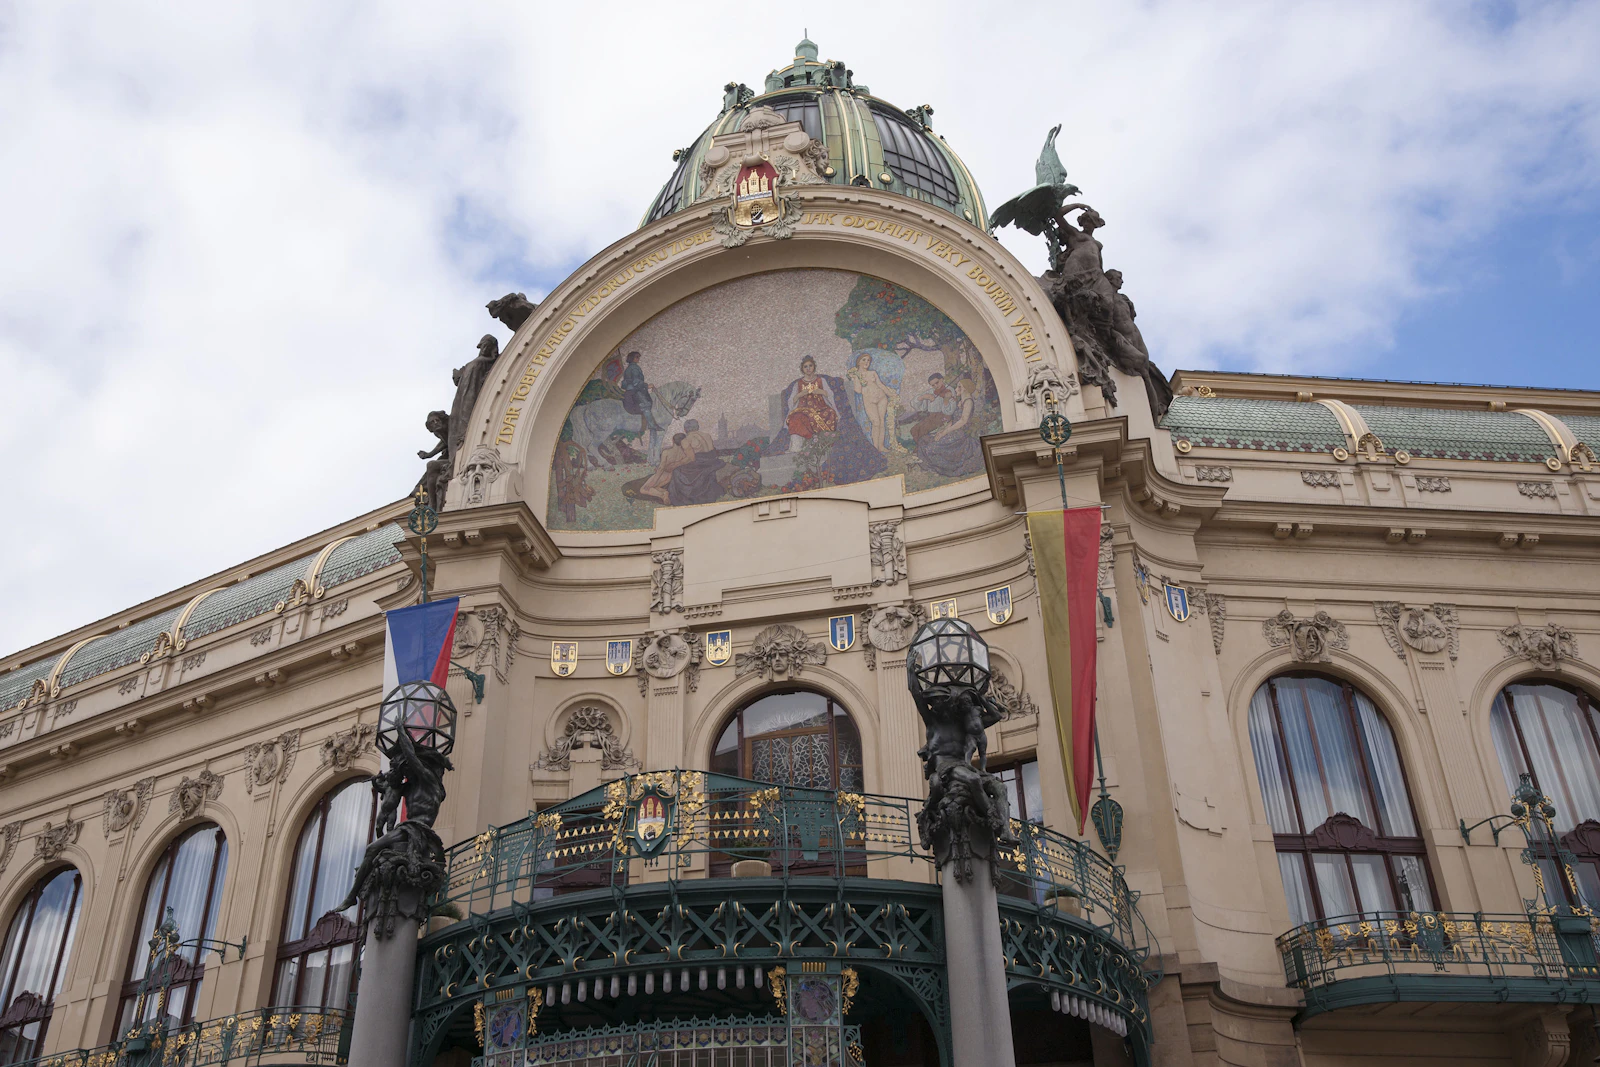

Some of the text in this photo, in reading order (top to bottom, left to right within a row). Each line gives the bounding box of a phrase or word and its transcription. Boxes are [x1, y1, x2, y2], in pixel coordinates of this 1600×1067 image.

[801, 212, 837, 225] JAK
[841, 215, 923, 244] ODOLALAS
[495, 406, 522, 446] ZDAR
[570, 268, 635, 317] VZDORUJ
